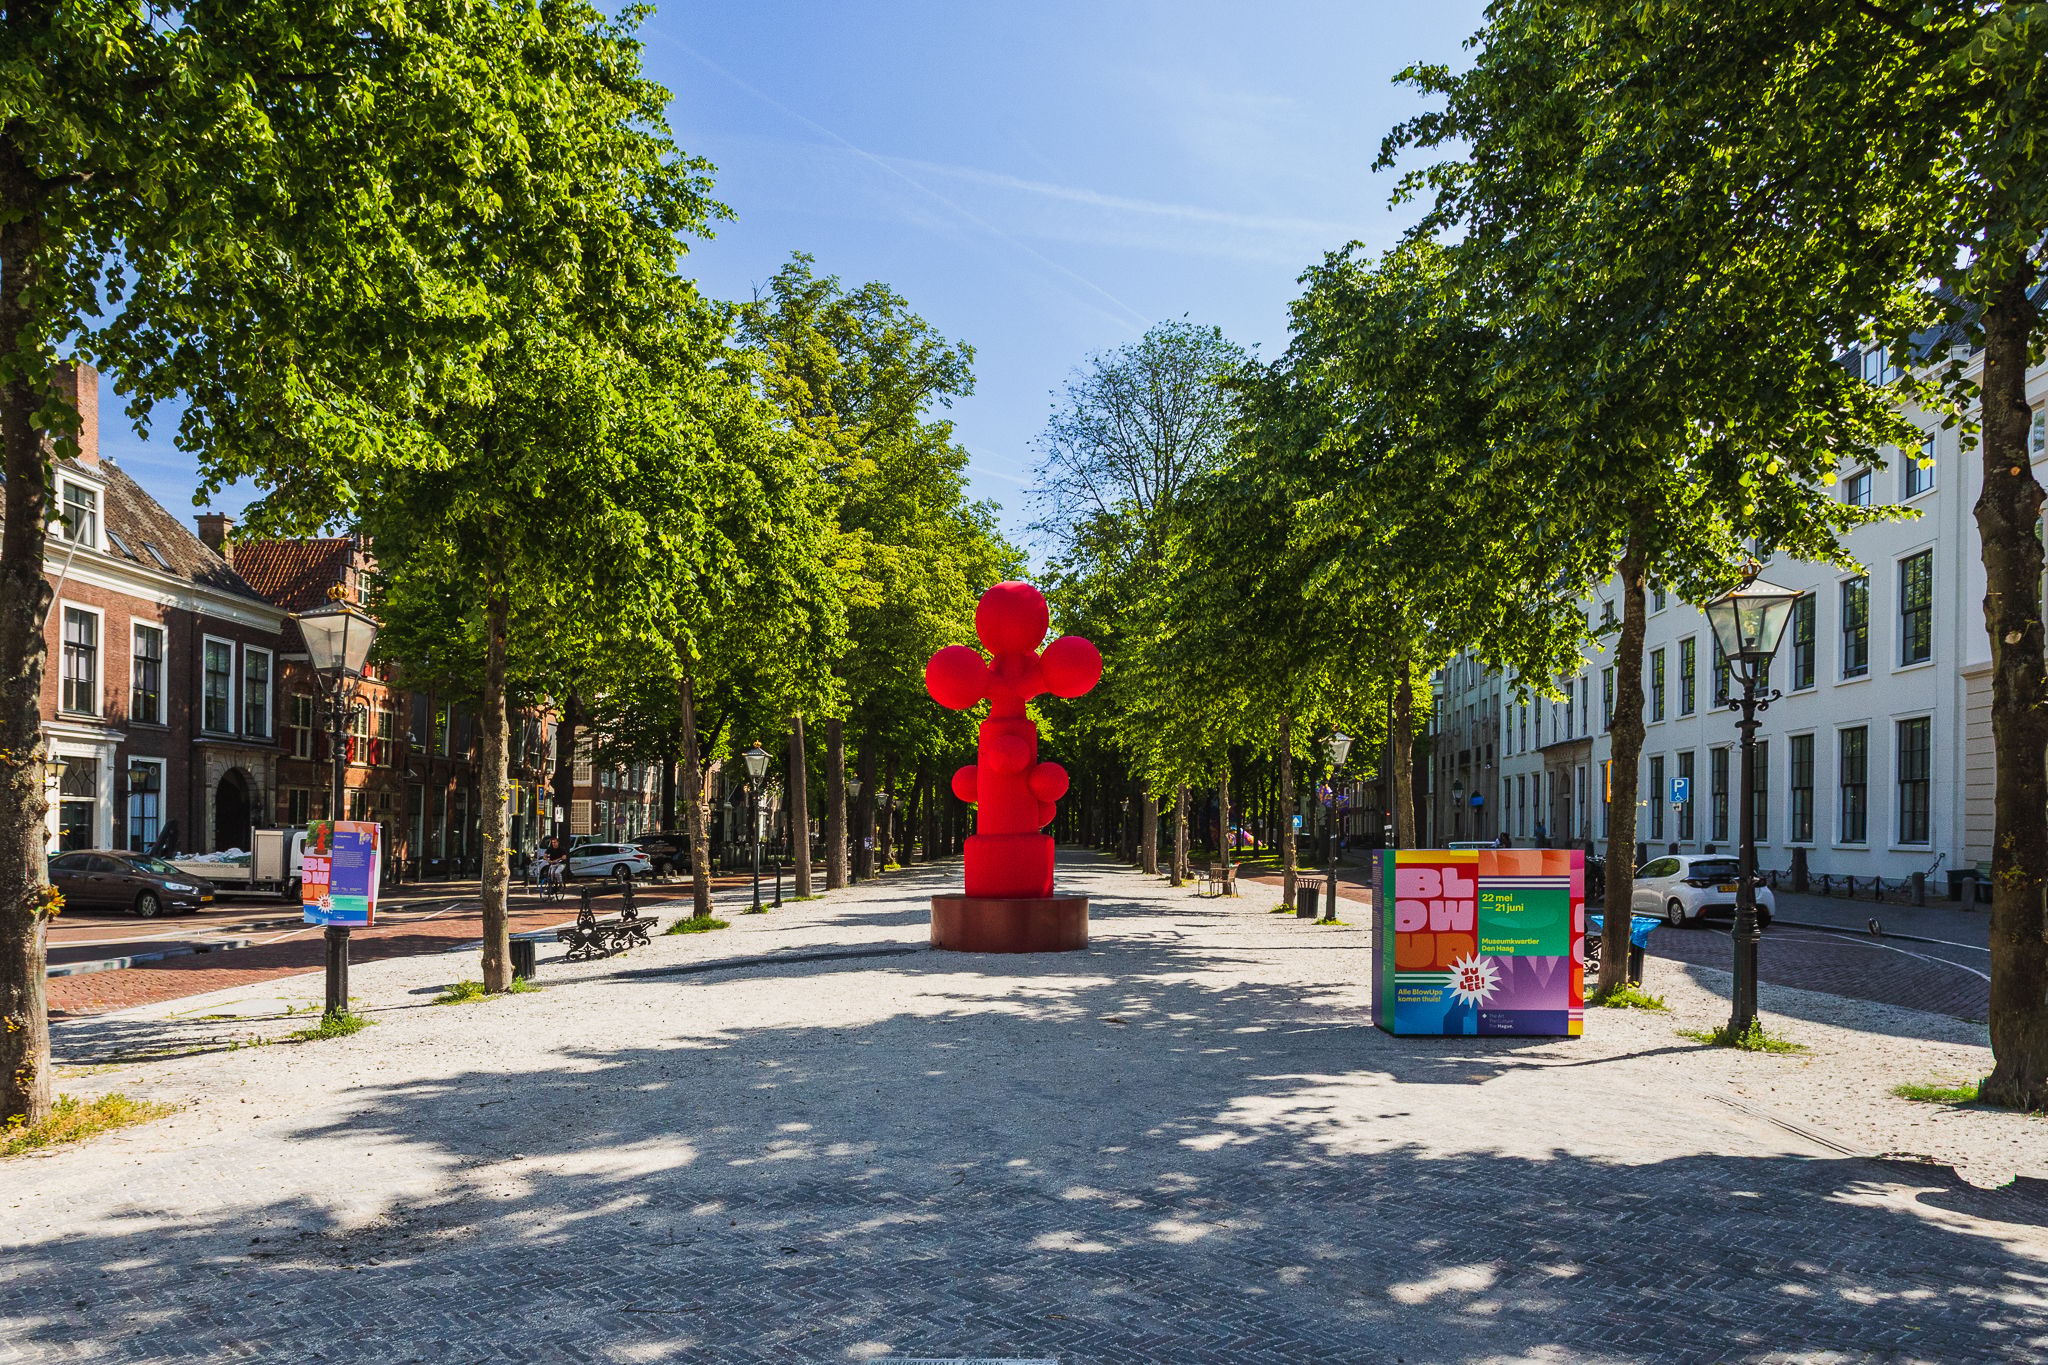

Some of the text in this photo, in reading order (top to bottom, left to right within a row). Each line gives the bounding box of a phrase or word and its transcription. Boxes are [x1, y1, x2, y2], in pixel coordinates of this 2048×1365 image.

[1674, 779, 1685, 793] P
[302, 857, 330, 871] BL
[1395, 867, 1474, 898] BL
[1481, 893, 1513, 902] 22 mei
[1495, 903, 1505, 912] 21
[1505, 903, 1524, 914] juni
[1395, 899, 1474, 932] OW
[1395, 933, 1475, 969] UP
[1496, 945, 1514, 953] Haag
[1461, 967, 1479, 976] JU
[1464, 975, 1480, 983] BI
